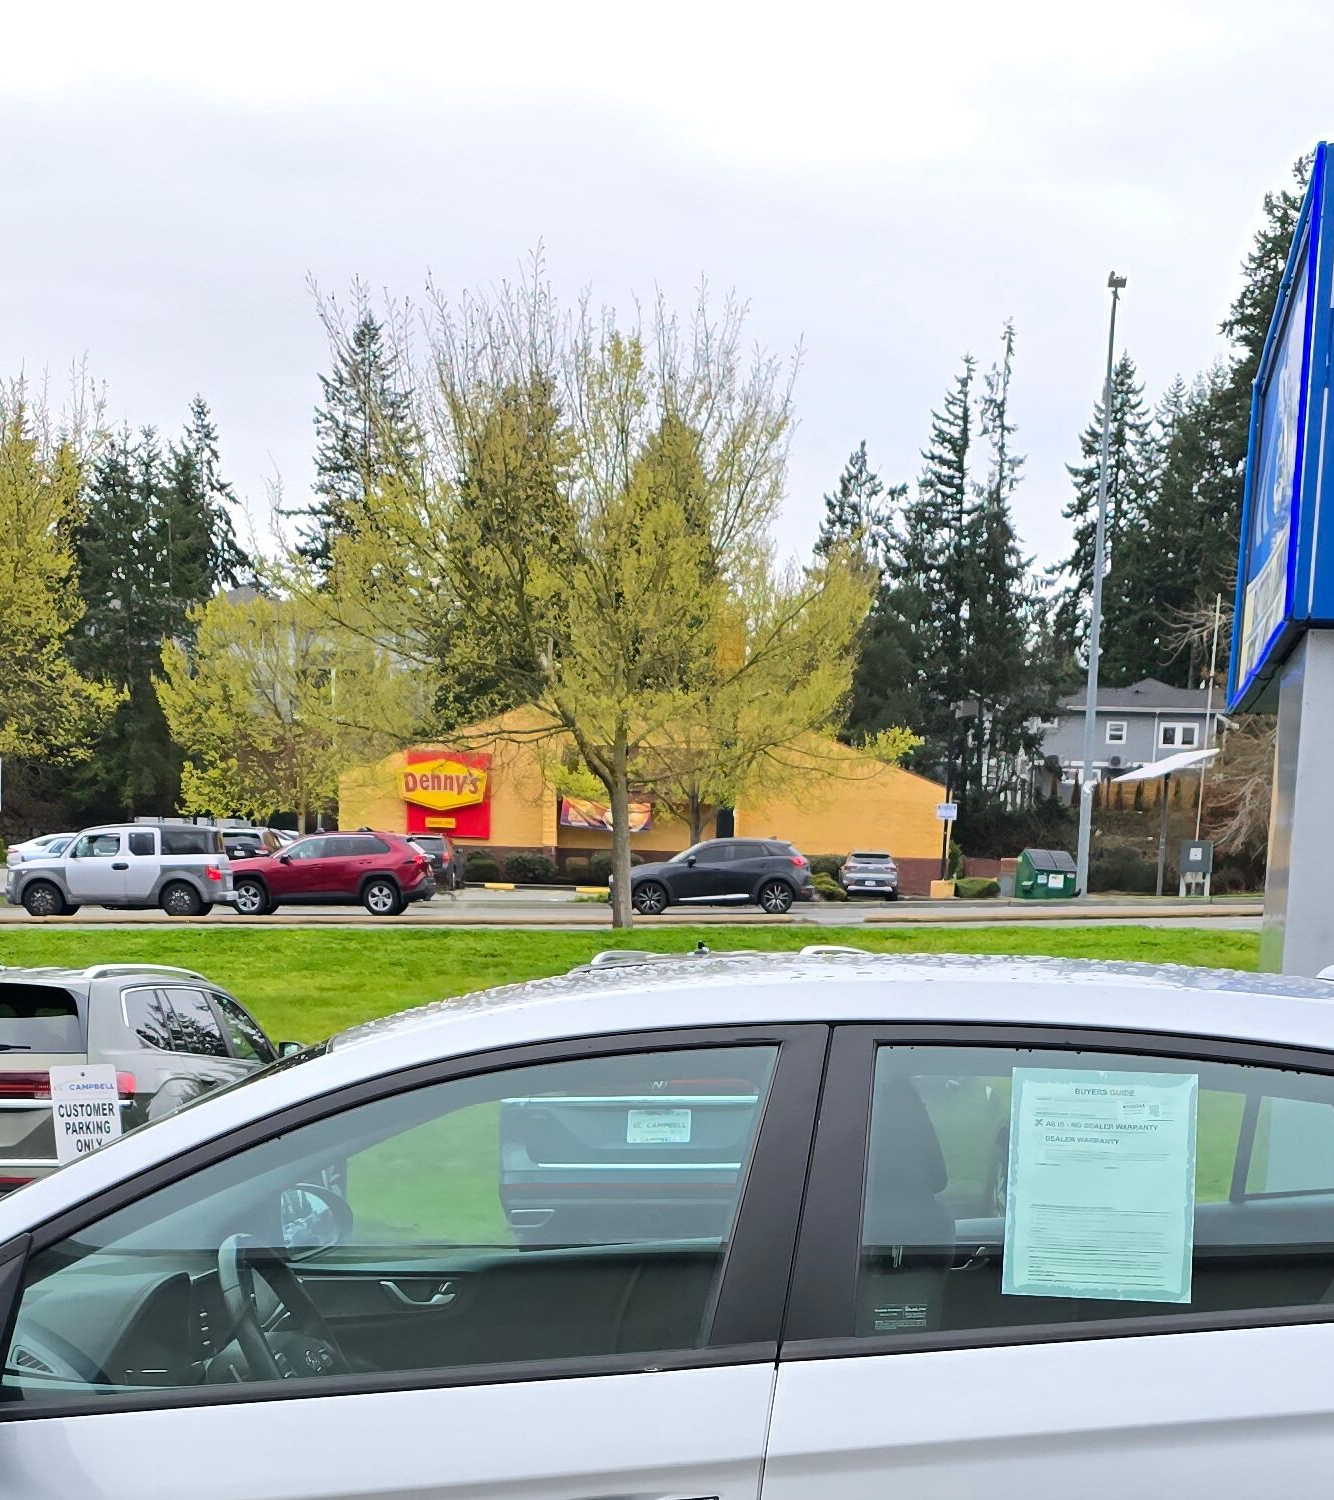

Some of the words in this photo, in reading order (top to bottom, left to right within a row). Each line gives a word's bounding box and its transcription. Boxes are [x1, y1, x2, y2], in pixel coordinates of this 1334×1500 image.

[403, 771, 480, 796] Denny's
[68, 1083, 115, 1091] CAMPBELL
[58, 1102, 116, 1118] CUSTOMER
[64, 1120, 111, 1136] PARKING
